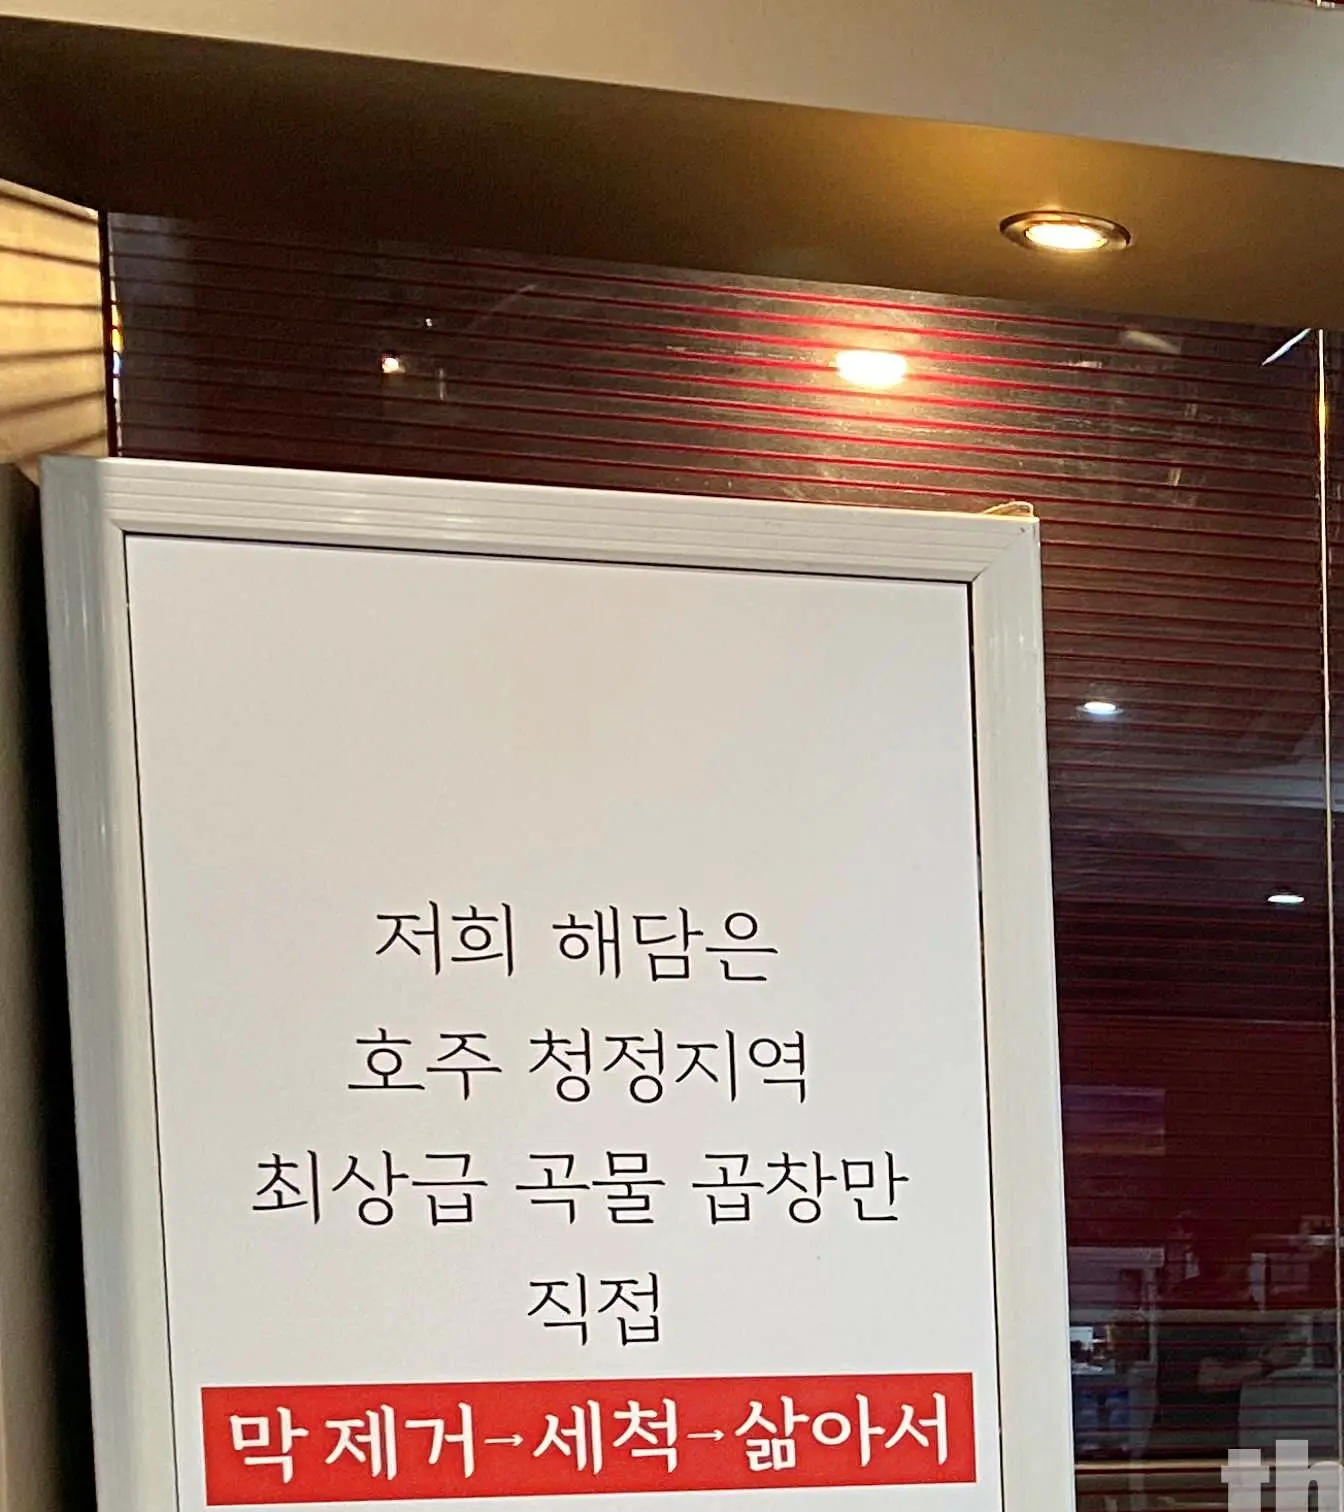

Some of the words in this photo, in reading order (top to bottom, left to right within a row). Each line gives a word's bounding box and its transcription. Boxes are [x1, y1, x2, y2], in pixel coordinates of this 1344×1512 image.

[374, 899, 516, 979] 저희
[552, 903, 779, 983] 해담은
[346, 1028, 504, 1101] 호주
[528, 1028, 810, 1105] 청정지역
[251, 1148, 490, 1227] 최상급
[514, 1148, 667, 1227] 곡물
[690, 1146, 909, 1227] 곱창만
[526, 1271, 663, 1347] 직접
[228, 1402, 309, 1486] 막
[322, 1400, 478, 1482] 제거
[530, 1398, 682, 1475] 세척
[732, 1390, 951, 1473] 삶아서
